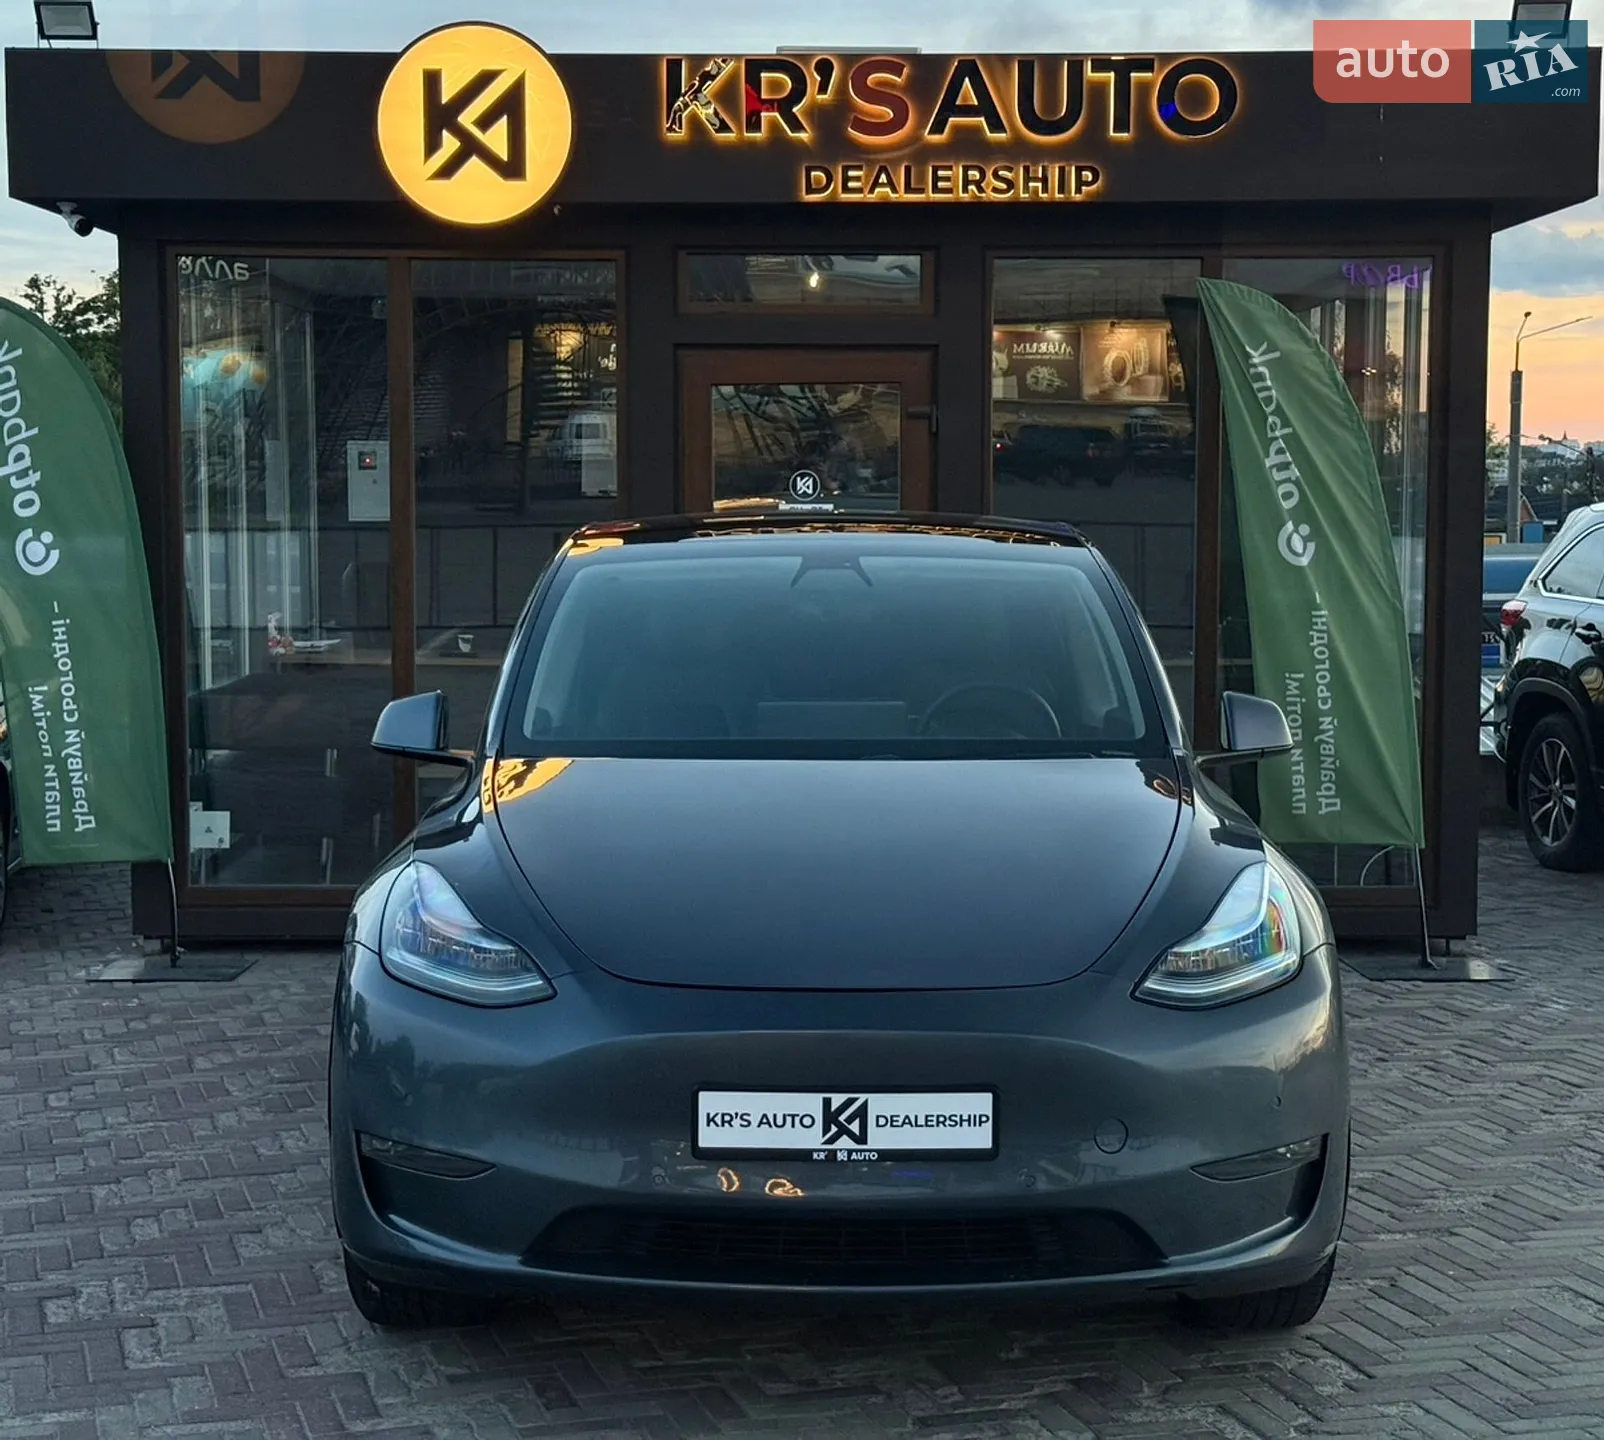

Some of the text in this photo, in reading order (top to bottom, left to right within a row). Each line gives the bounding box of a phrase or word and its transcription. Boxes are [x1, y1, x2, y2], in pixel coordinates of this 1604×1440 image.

[664, 56, 1239, 139] KR'S AUTO
[803, 163, 1102, 199] DEALERSHIP
[706, 1112, 752, 1128] KR'S
[757, 1112, 815, 1129] AUTO
[875, 1113, 990, 1128] DEALERSHIP
[850, 1151, 878, 1160] AUTO
